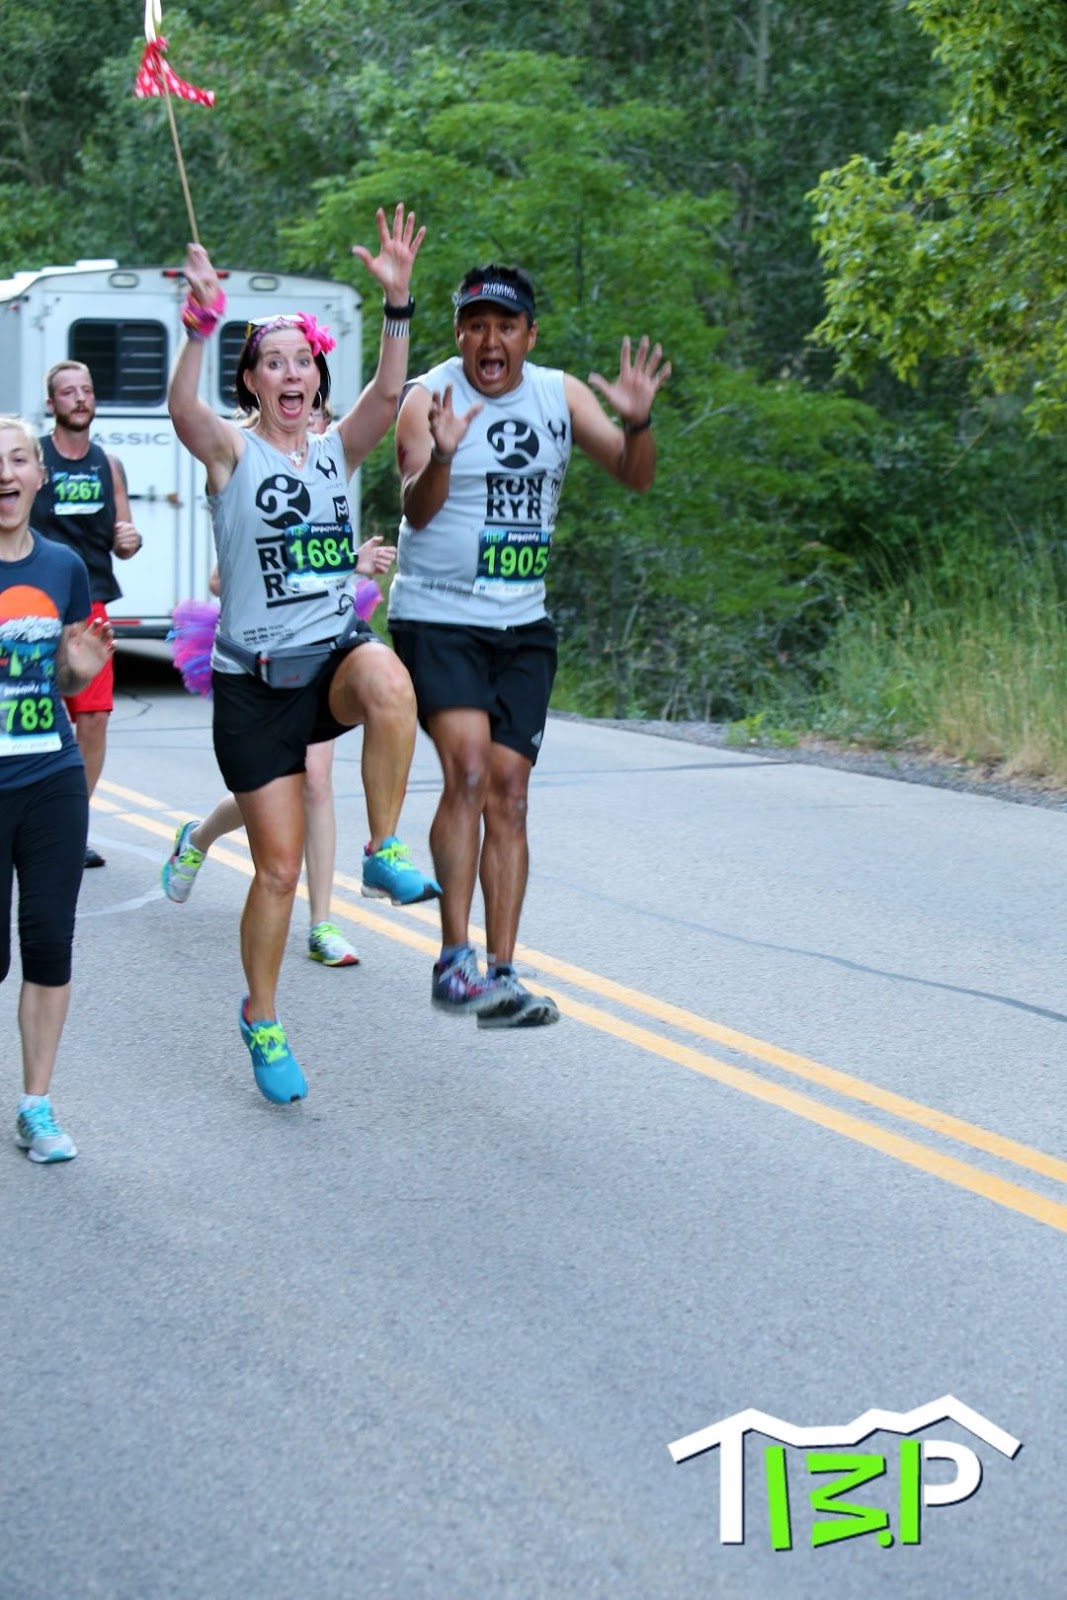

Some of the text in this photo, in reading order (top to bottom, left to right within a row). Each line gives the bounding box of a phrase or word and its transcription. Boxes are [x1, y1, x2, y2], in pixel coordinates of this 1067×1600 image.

[55, 481, 101, 501] 1267
[486, 476, 544, 496] RUN
[486, 498, 542, 519] RYR
[289, 537, 355, 569] 1681
[483, 544, 549, 577] 1905
[0, 697, 54, 731] 783
